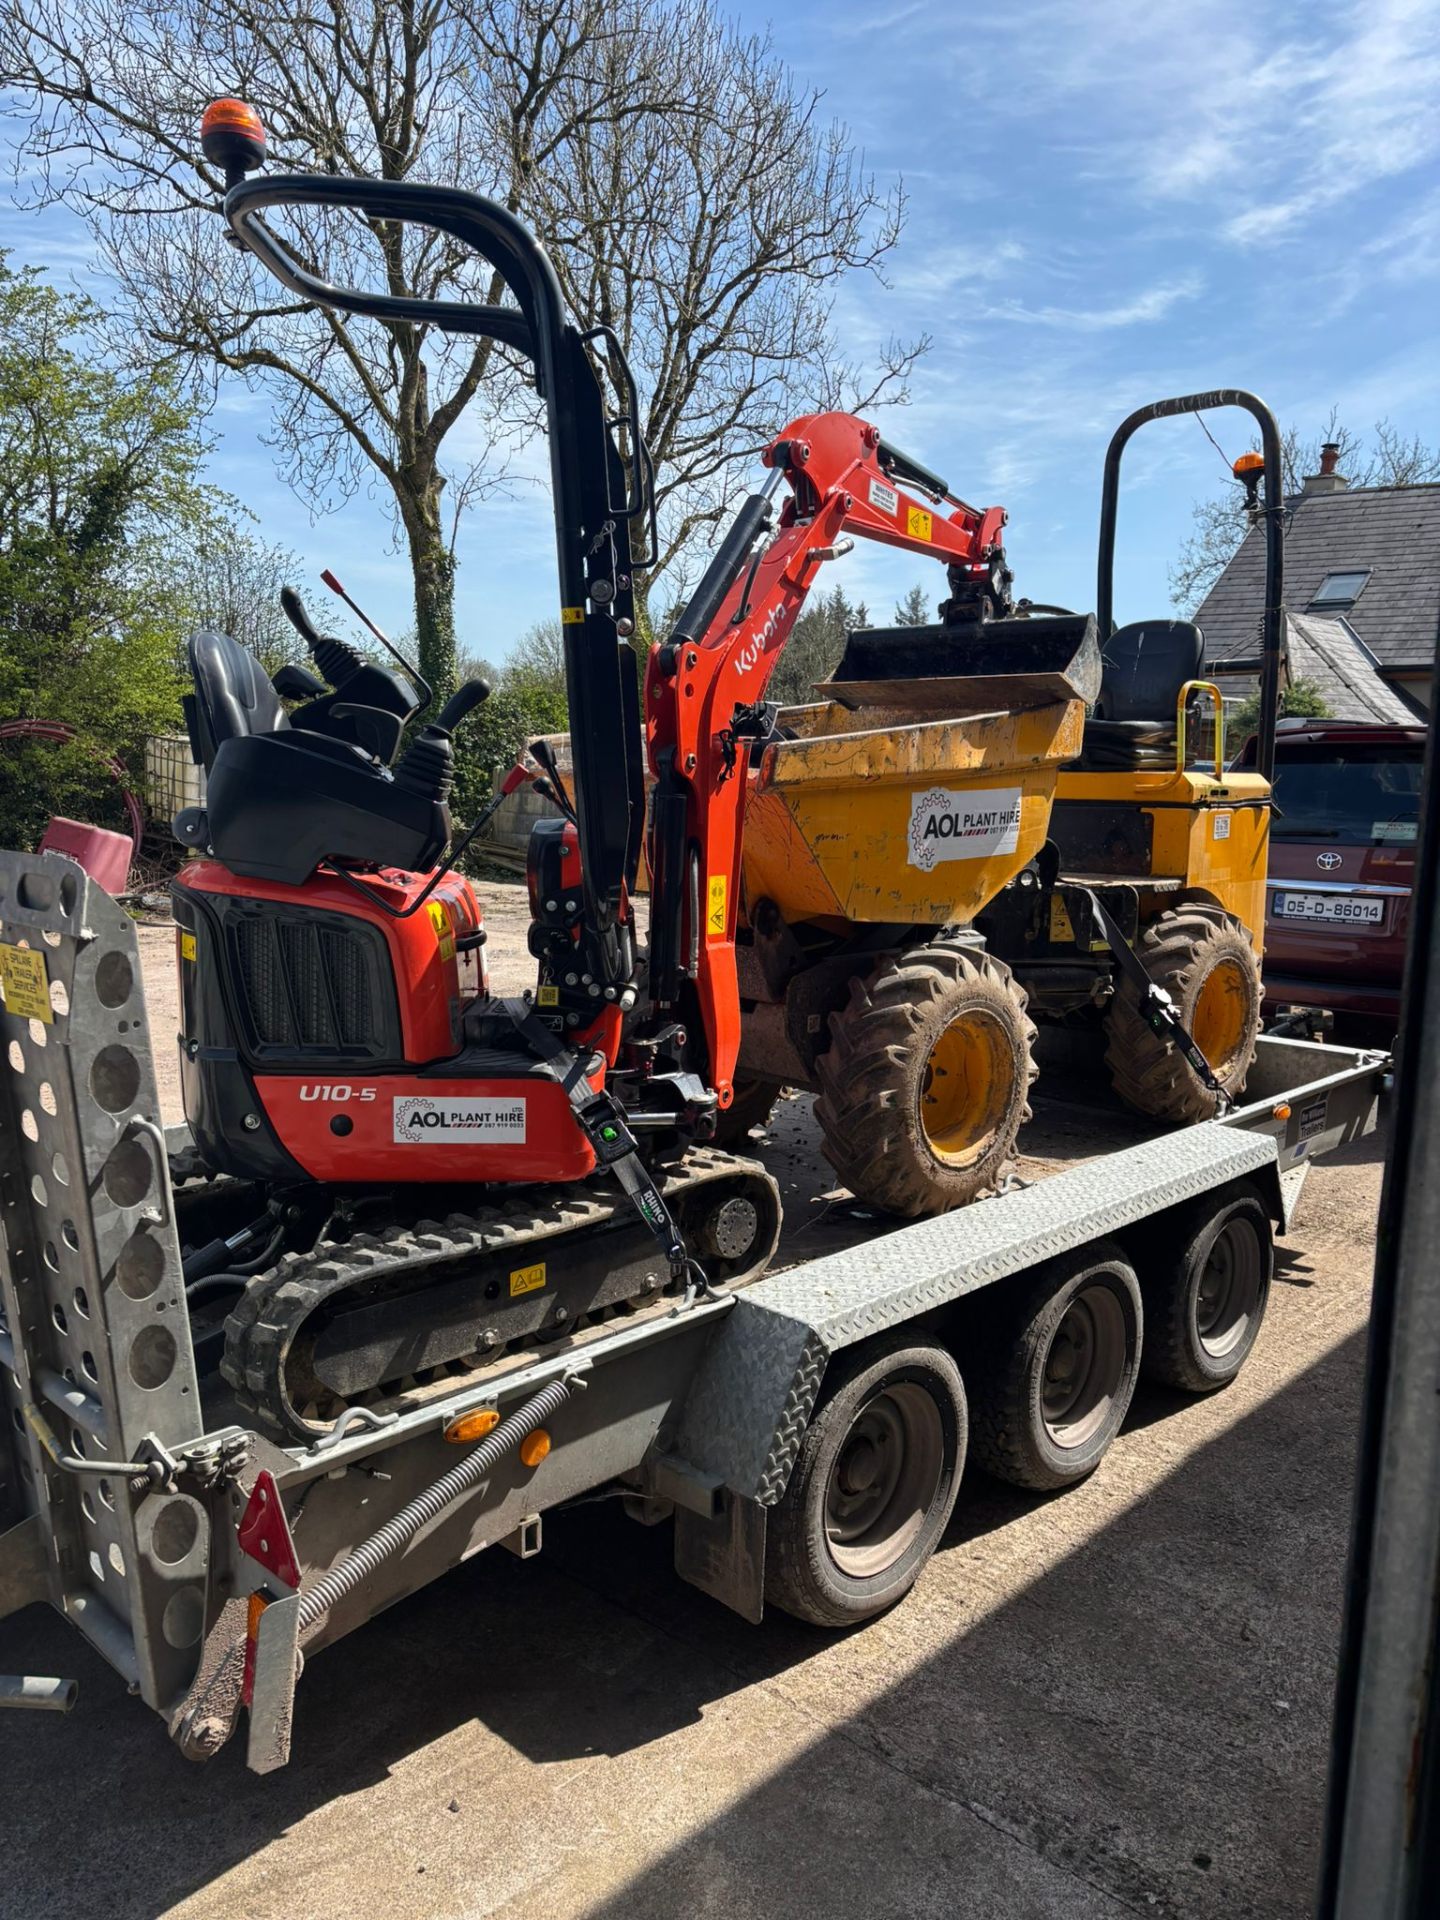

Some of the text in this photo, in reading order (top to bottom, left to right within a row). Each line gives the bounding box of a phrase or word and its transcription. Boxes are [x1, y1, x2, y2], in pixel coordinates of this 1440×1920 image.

[734, 602, 787, 676] Kubota
[923, 810, 1020, 839] AOL PLANT HIRE
[1287, 900, 1378, 919] 05-D-86014
[300, 1085, 377, 1102] U10-5
[408, 1111, 524, 1128] AOL PLANT HIRE
[643, 1190, 665, 1224] RHINO
